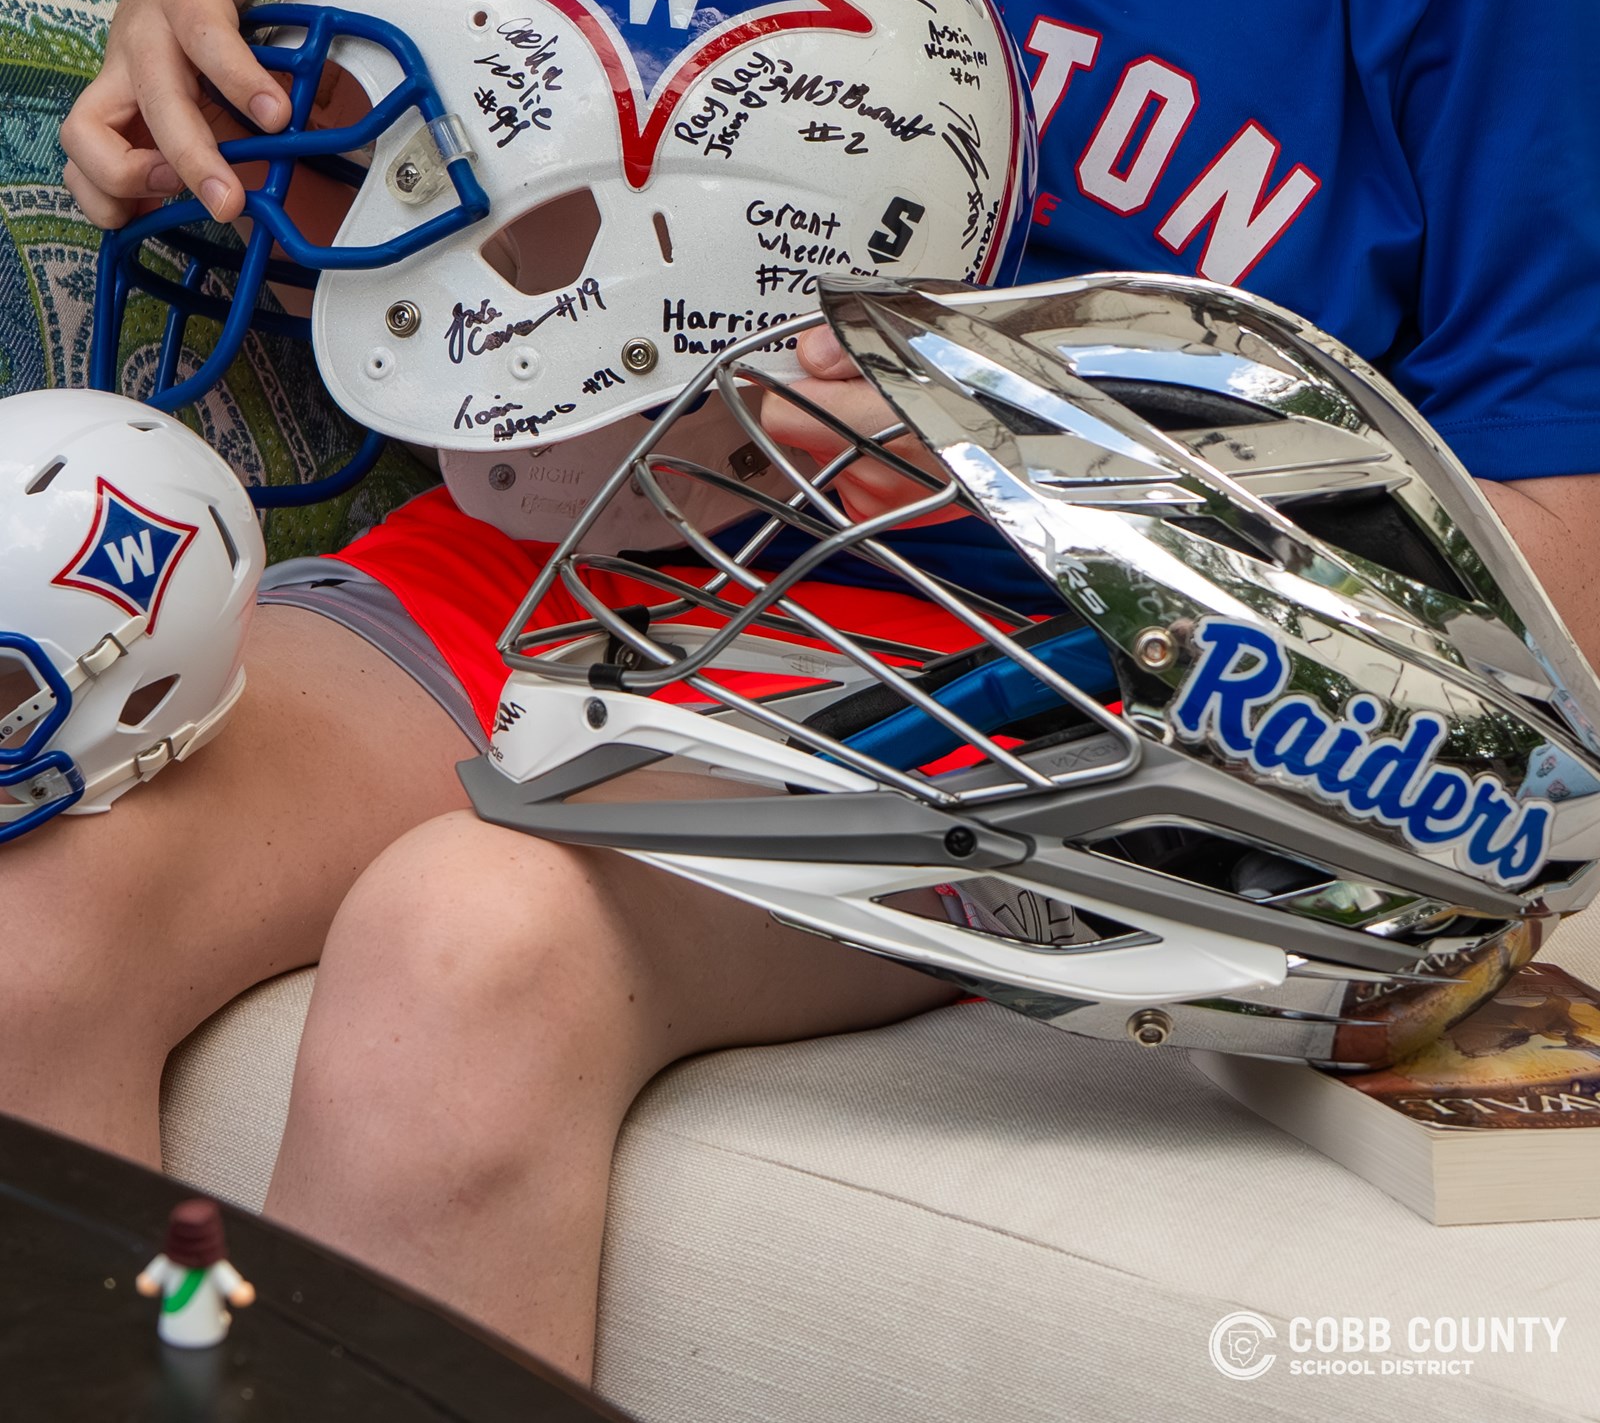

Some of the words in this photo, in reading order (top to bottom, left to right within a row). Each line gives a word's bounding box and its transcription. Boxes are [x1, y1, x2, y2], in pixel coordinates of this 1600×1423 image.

[745, 199, 841, 239] Grant
[582, 367, 626, 395] #21
[103, 528, 155, 585] W
[1174, 619, 1553, 883] Raiders
[1399, 1092, 1600, 1116] WALL
